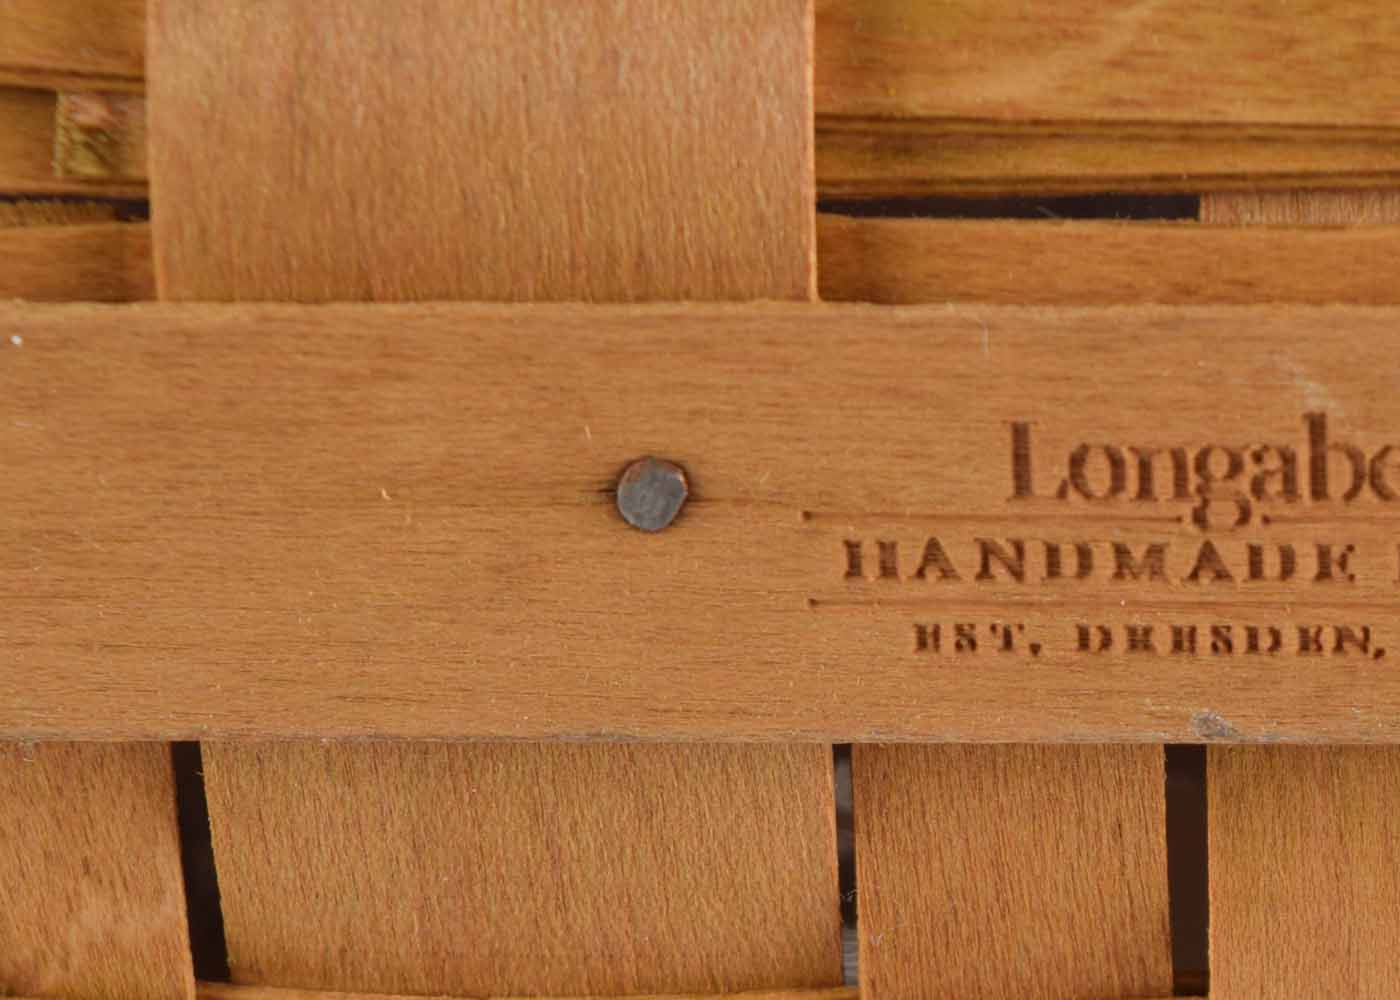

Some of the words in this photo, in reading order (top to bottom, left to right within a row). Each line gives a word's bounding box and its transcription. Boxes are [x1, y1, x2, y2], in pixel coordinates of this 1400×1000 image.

[842, 537, 1358, 583] HANDMADE
[914, 622, 1043, 659] EST.
[1074, 622, 1387, 662] DRESDEN,
